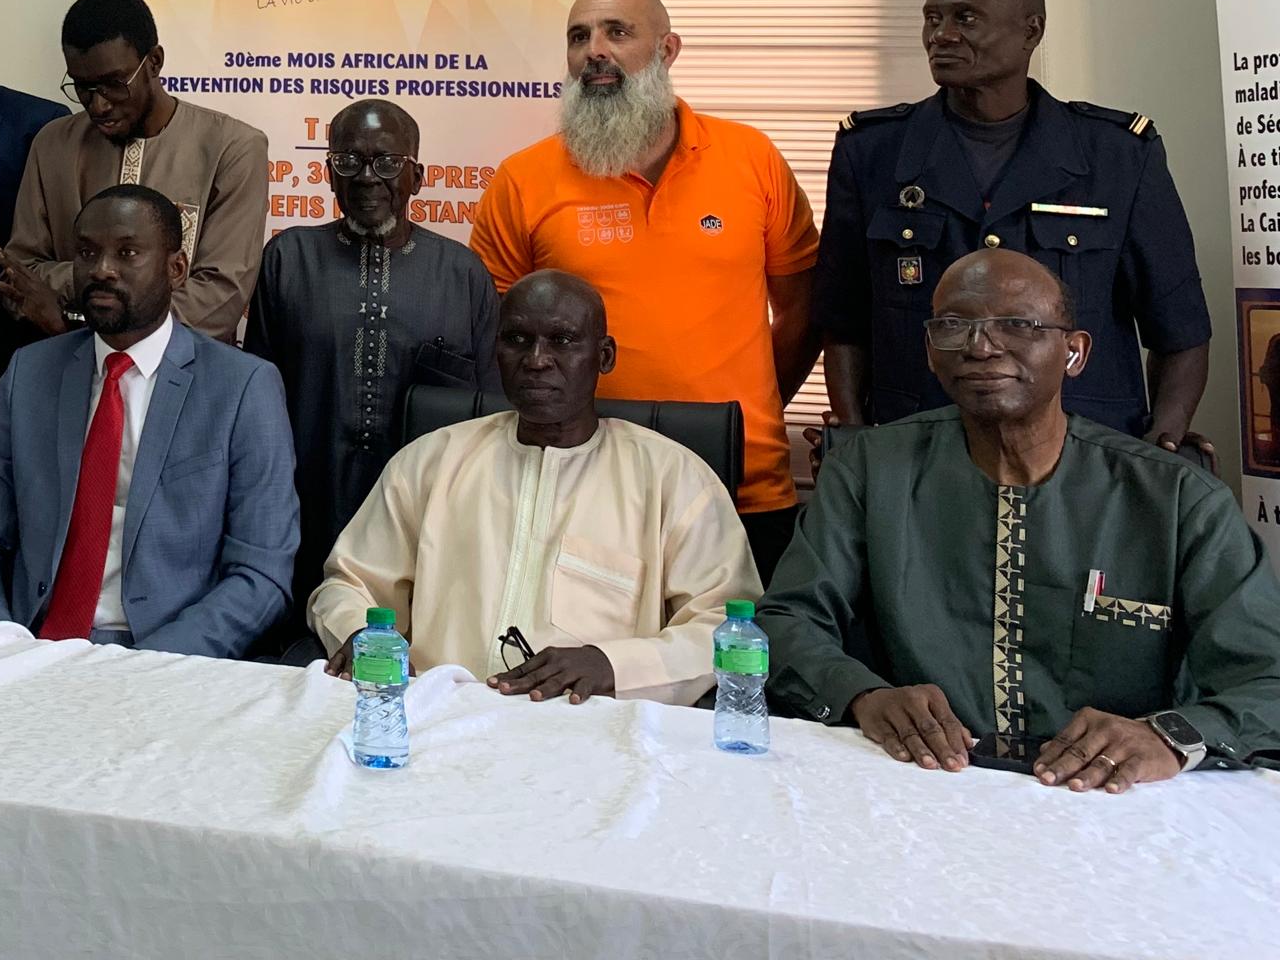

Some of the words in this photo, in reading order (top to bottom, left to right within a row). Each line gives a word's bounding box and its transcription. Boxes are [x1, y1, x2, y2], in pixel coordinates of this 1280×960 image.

[224, 51, 282, 68] 30ème
[287, 52, 335, 69] MOIS
[341, 53, 428, 70] AFRICAIN
[435, 54, 460, 70] DE
[465, 54, 489, 71] LA
[1233, 52, 1249, 71] La
[1253, 53, 1280, 75] pro
[158, 76, 264, 94] PREVENTION
[269, 77, 305, 95] DES
[310, 78, 390, 100] RISQUES
[395, 79, 564, 99] PROFESSIONNELS
[1235, 80, 1280, 104] malad
[1236, 115, 1253, 136] de
[1238, 143, 1247, 168] À
[1250, 152, 1267, 168] ce
[1240, 212, 1255, 233] La
[1242, 245, 1261, 266] les
[1257, 495, 1269, 524] À
